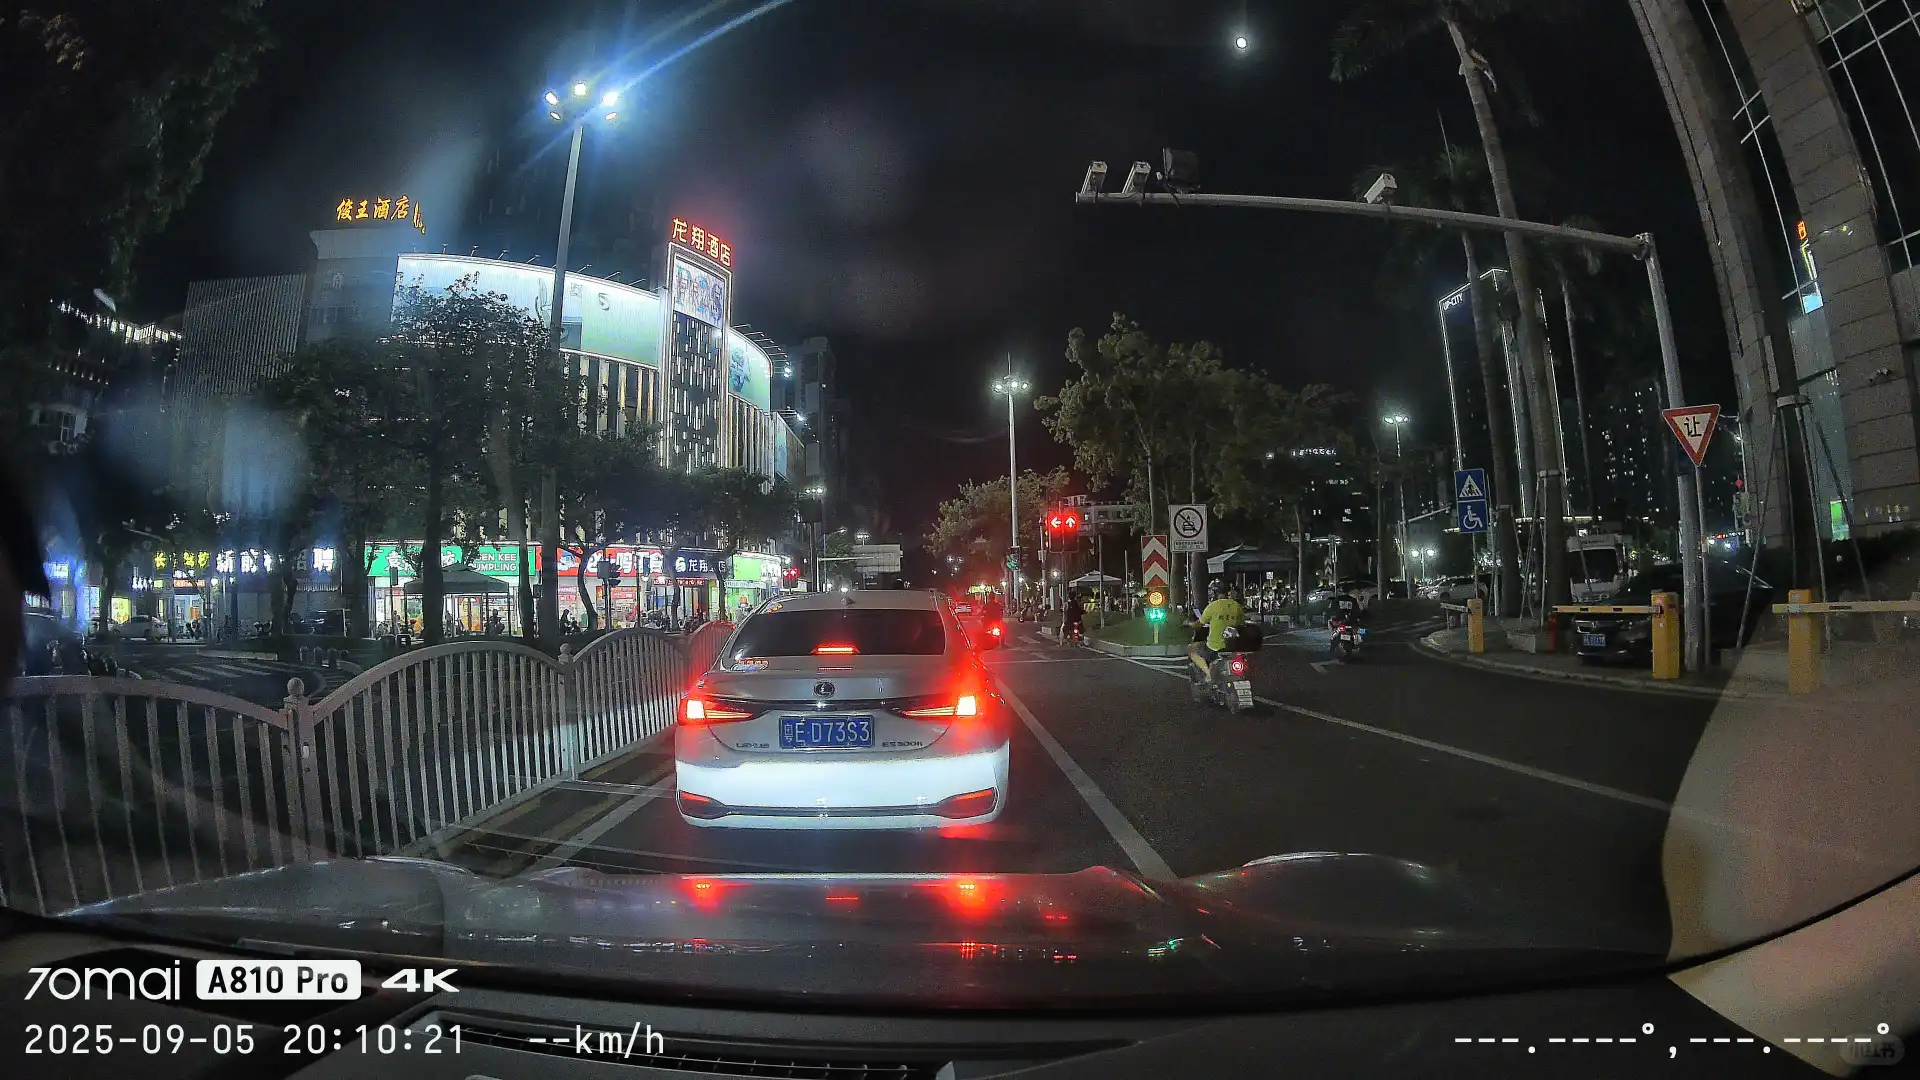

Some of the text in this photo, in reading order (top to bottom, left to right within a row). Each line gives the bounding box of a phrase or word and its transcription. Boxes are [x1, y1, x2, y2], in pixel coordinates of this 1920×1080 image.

[672, 217, 731, 267] 龙翔酒店
[1684, 416, 1702, 437] 让
[498, 553, 516, 562] KEE
